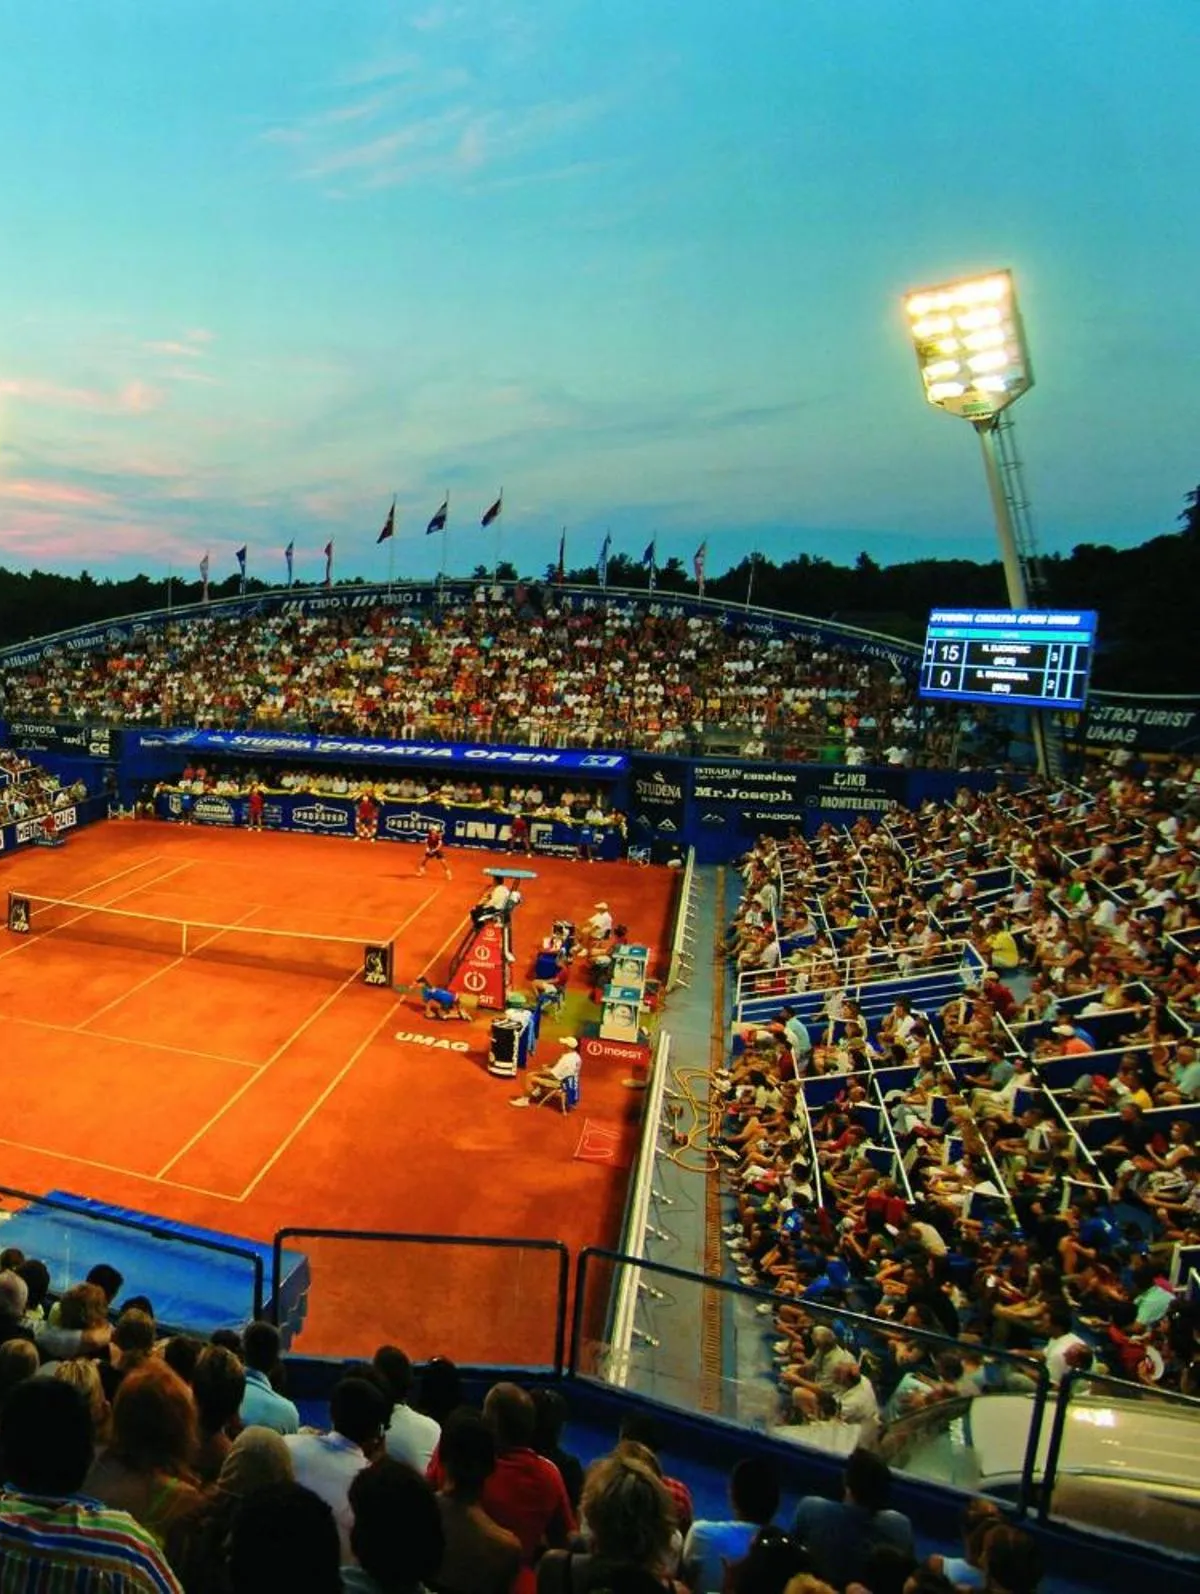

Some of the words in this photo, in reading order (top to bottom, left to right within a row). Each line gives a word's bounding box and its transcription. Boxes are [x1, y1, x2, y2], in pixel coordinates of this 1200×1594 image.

[940, 644, 960, 662] 15
[1051, 652, 1058, 662] 3
[940, 670, 951, 687] 0
[1048, 680, 1055, 689] 2
[1086, 725, 1138, 743] UMAG
[318, 741, 452, 757] CROATIA
[464, 750, 560, 763] OPEN
[636, 779, 682, 799] STUDENA
